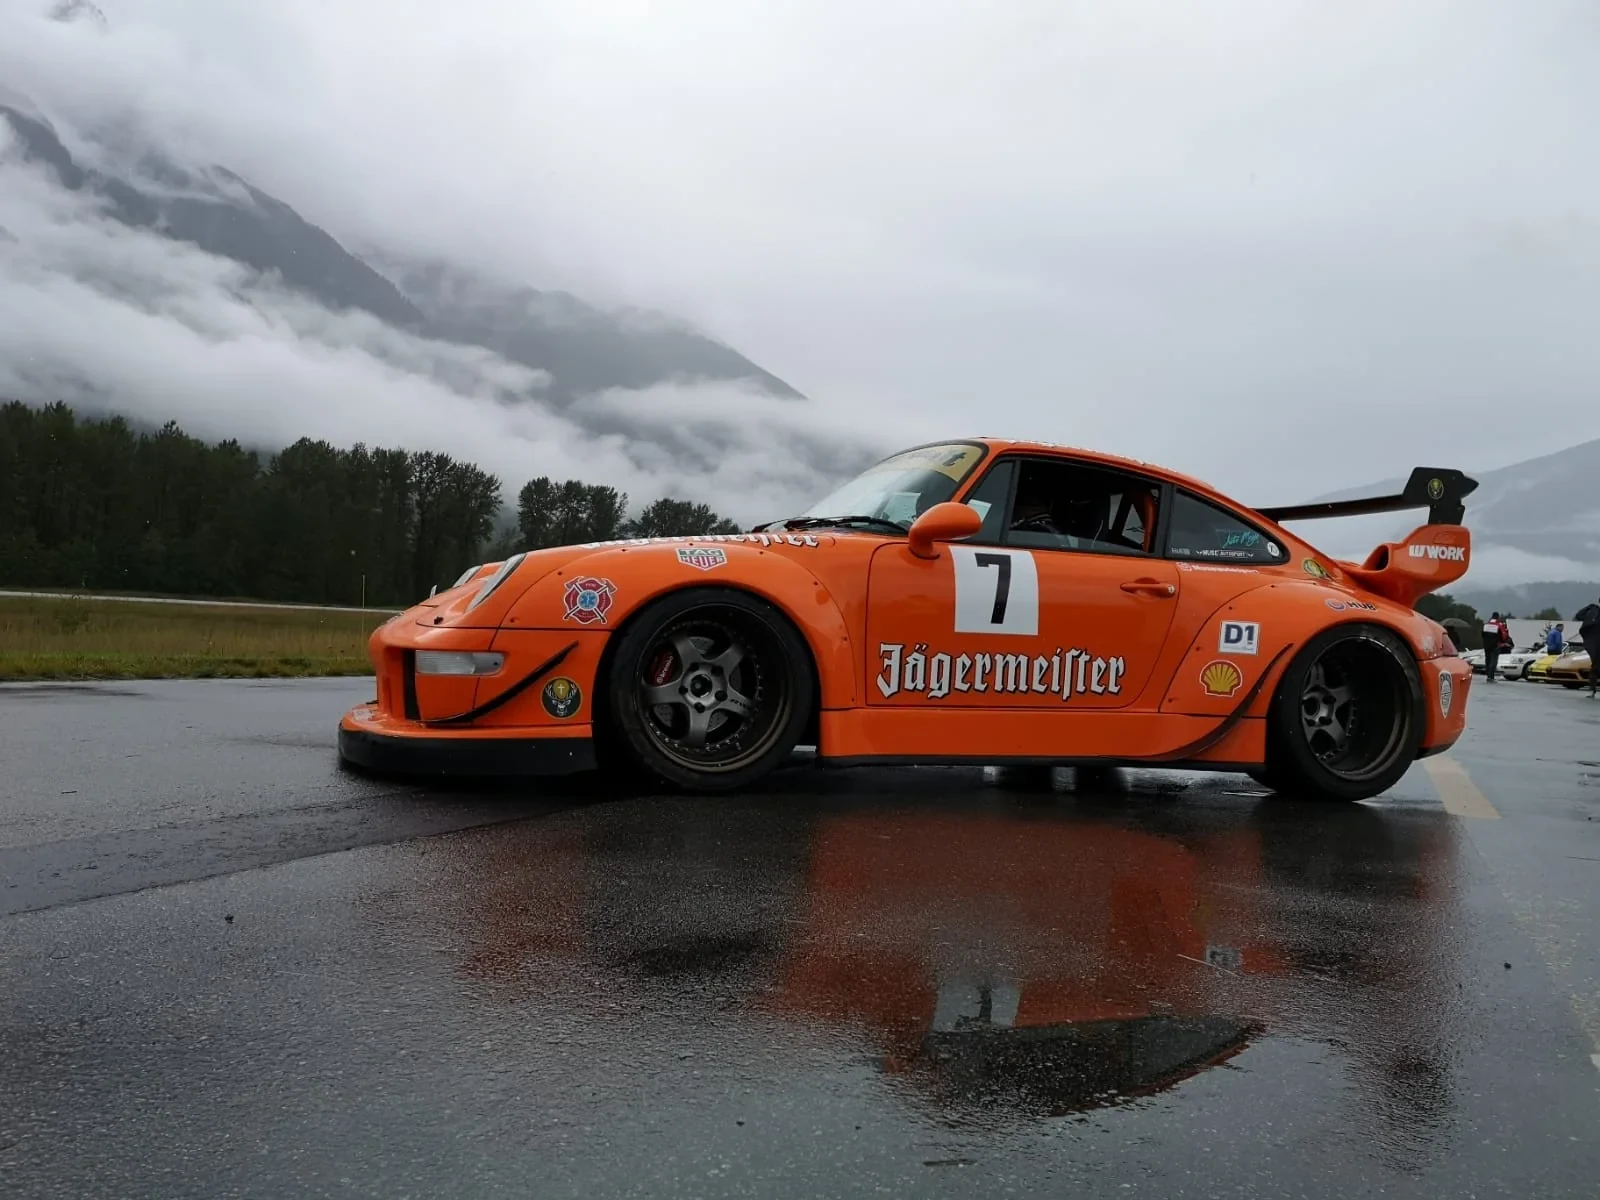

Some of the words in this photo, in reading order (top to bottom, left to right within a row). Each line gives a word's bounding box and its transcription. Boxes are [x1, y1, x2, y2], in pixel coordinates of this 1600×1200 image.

[680, 556, 725, 568] HEUER
[974, 552, 1012, 624] 7
[1224, 624, 1255, 645] D1
[876, 643, 1126, 701] Jägermeister
